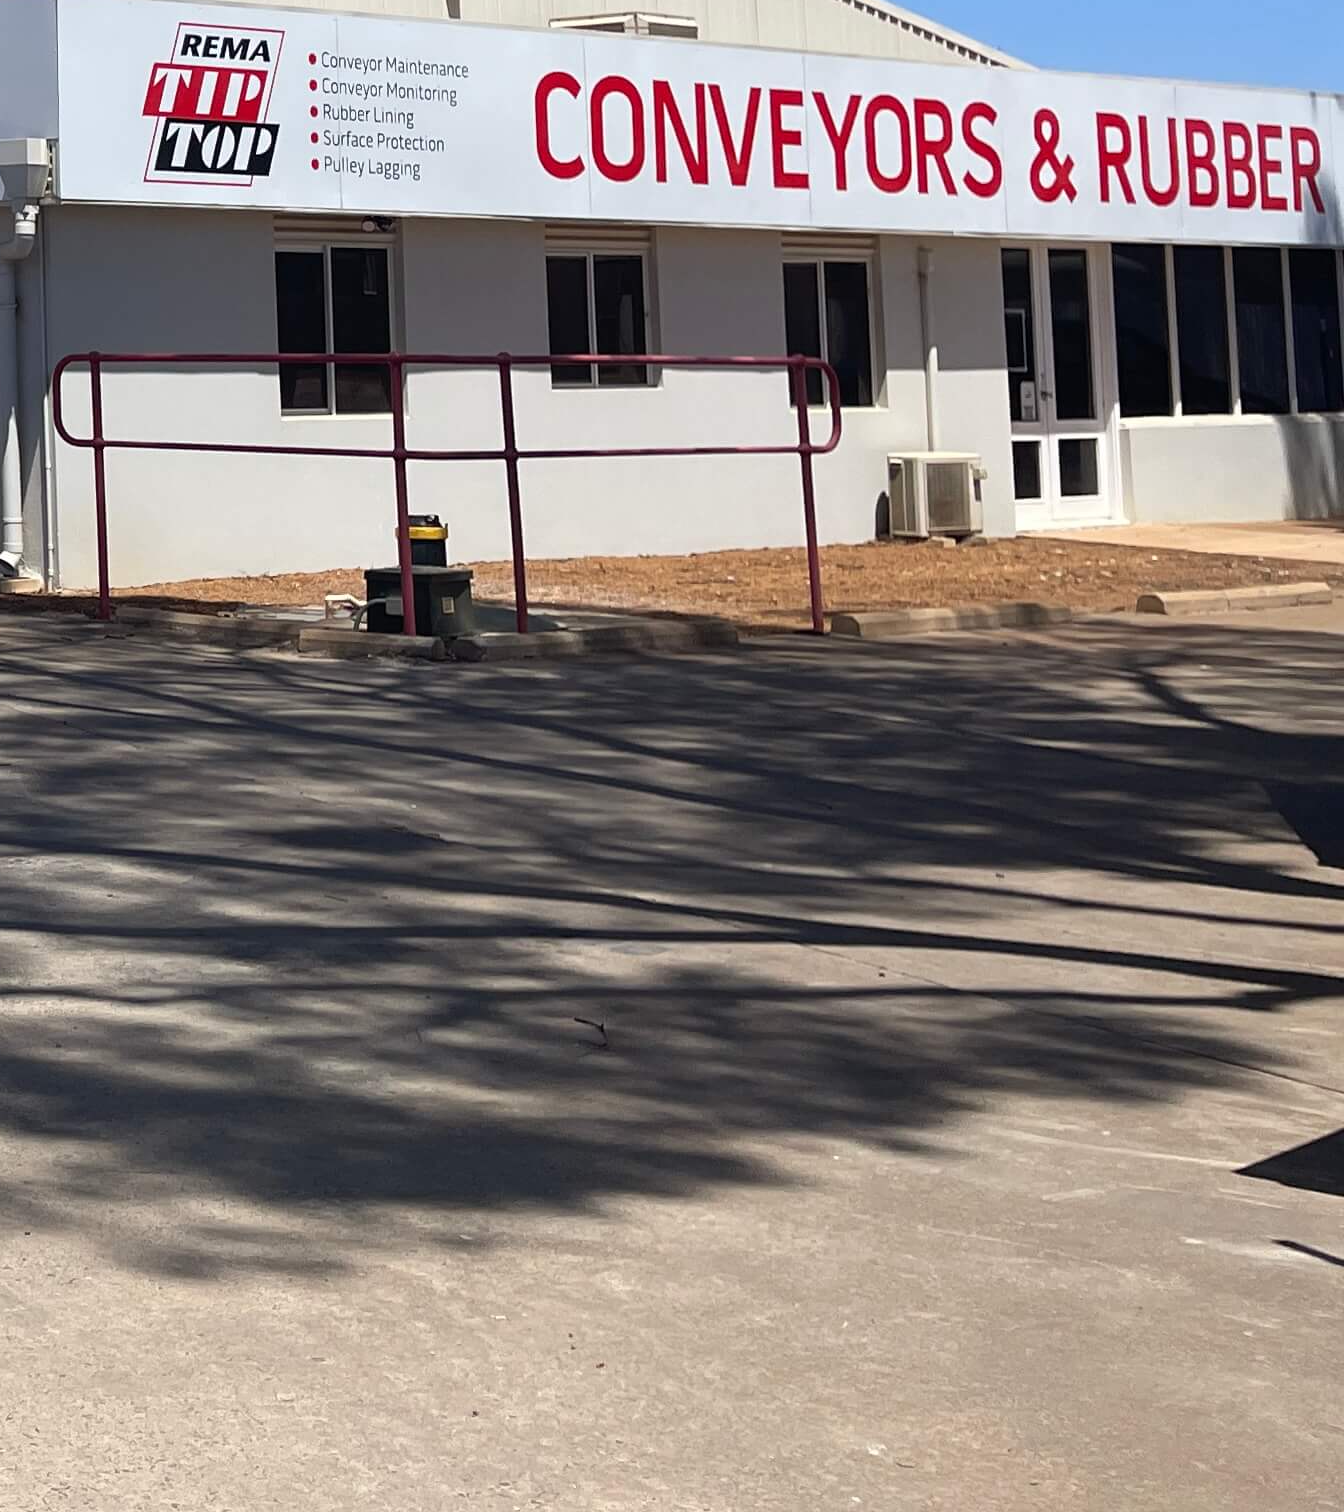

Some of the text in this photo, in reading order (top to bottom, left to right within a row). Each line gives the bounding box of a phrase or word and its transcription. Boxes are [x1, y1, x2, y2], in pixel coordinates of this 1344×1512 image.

[181, 34, 271, 62] REMA
[321, 51, 469, 78] Conveyor Maintenance
[153, 68, 262, 117] TIP
[321, 77, 457, 107] Conveyor Monitoring
[323, 104, 414, 129] Rubber Lining
[166, 122, 272, 171] TOP
[323, 129, 445, 152] Surface Protection
[534, 71, 1326, 214] CONVEYORS & RUBBER
[324, 156, 421, 181] Pulley Lagging
